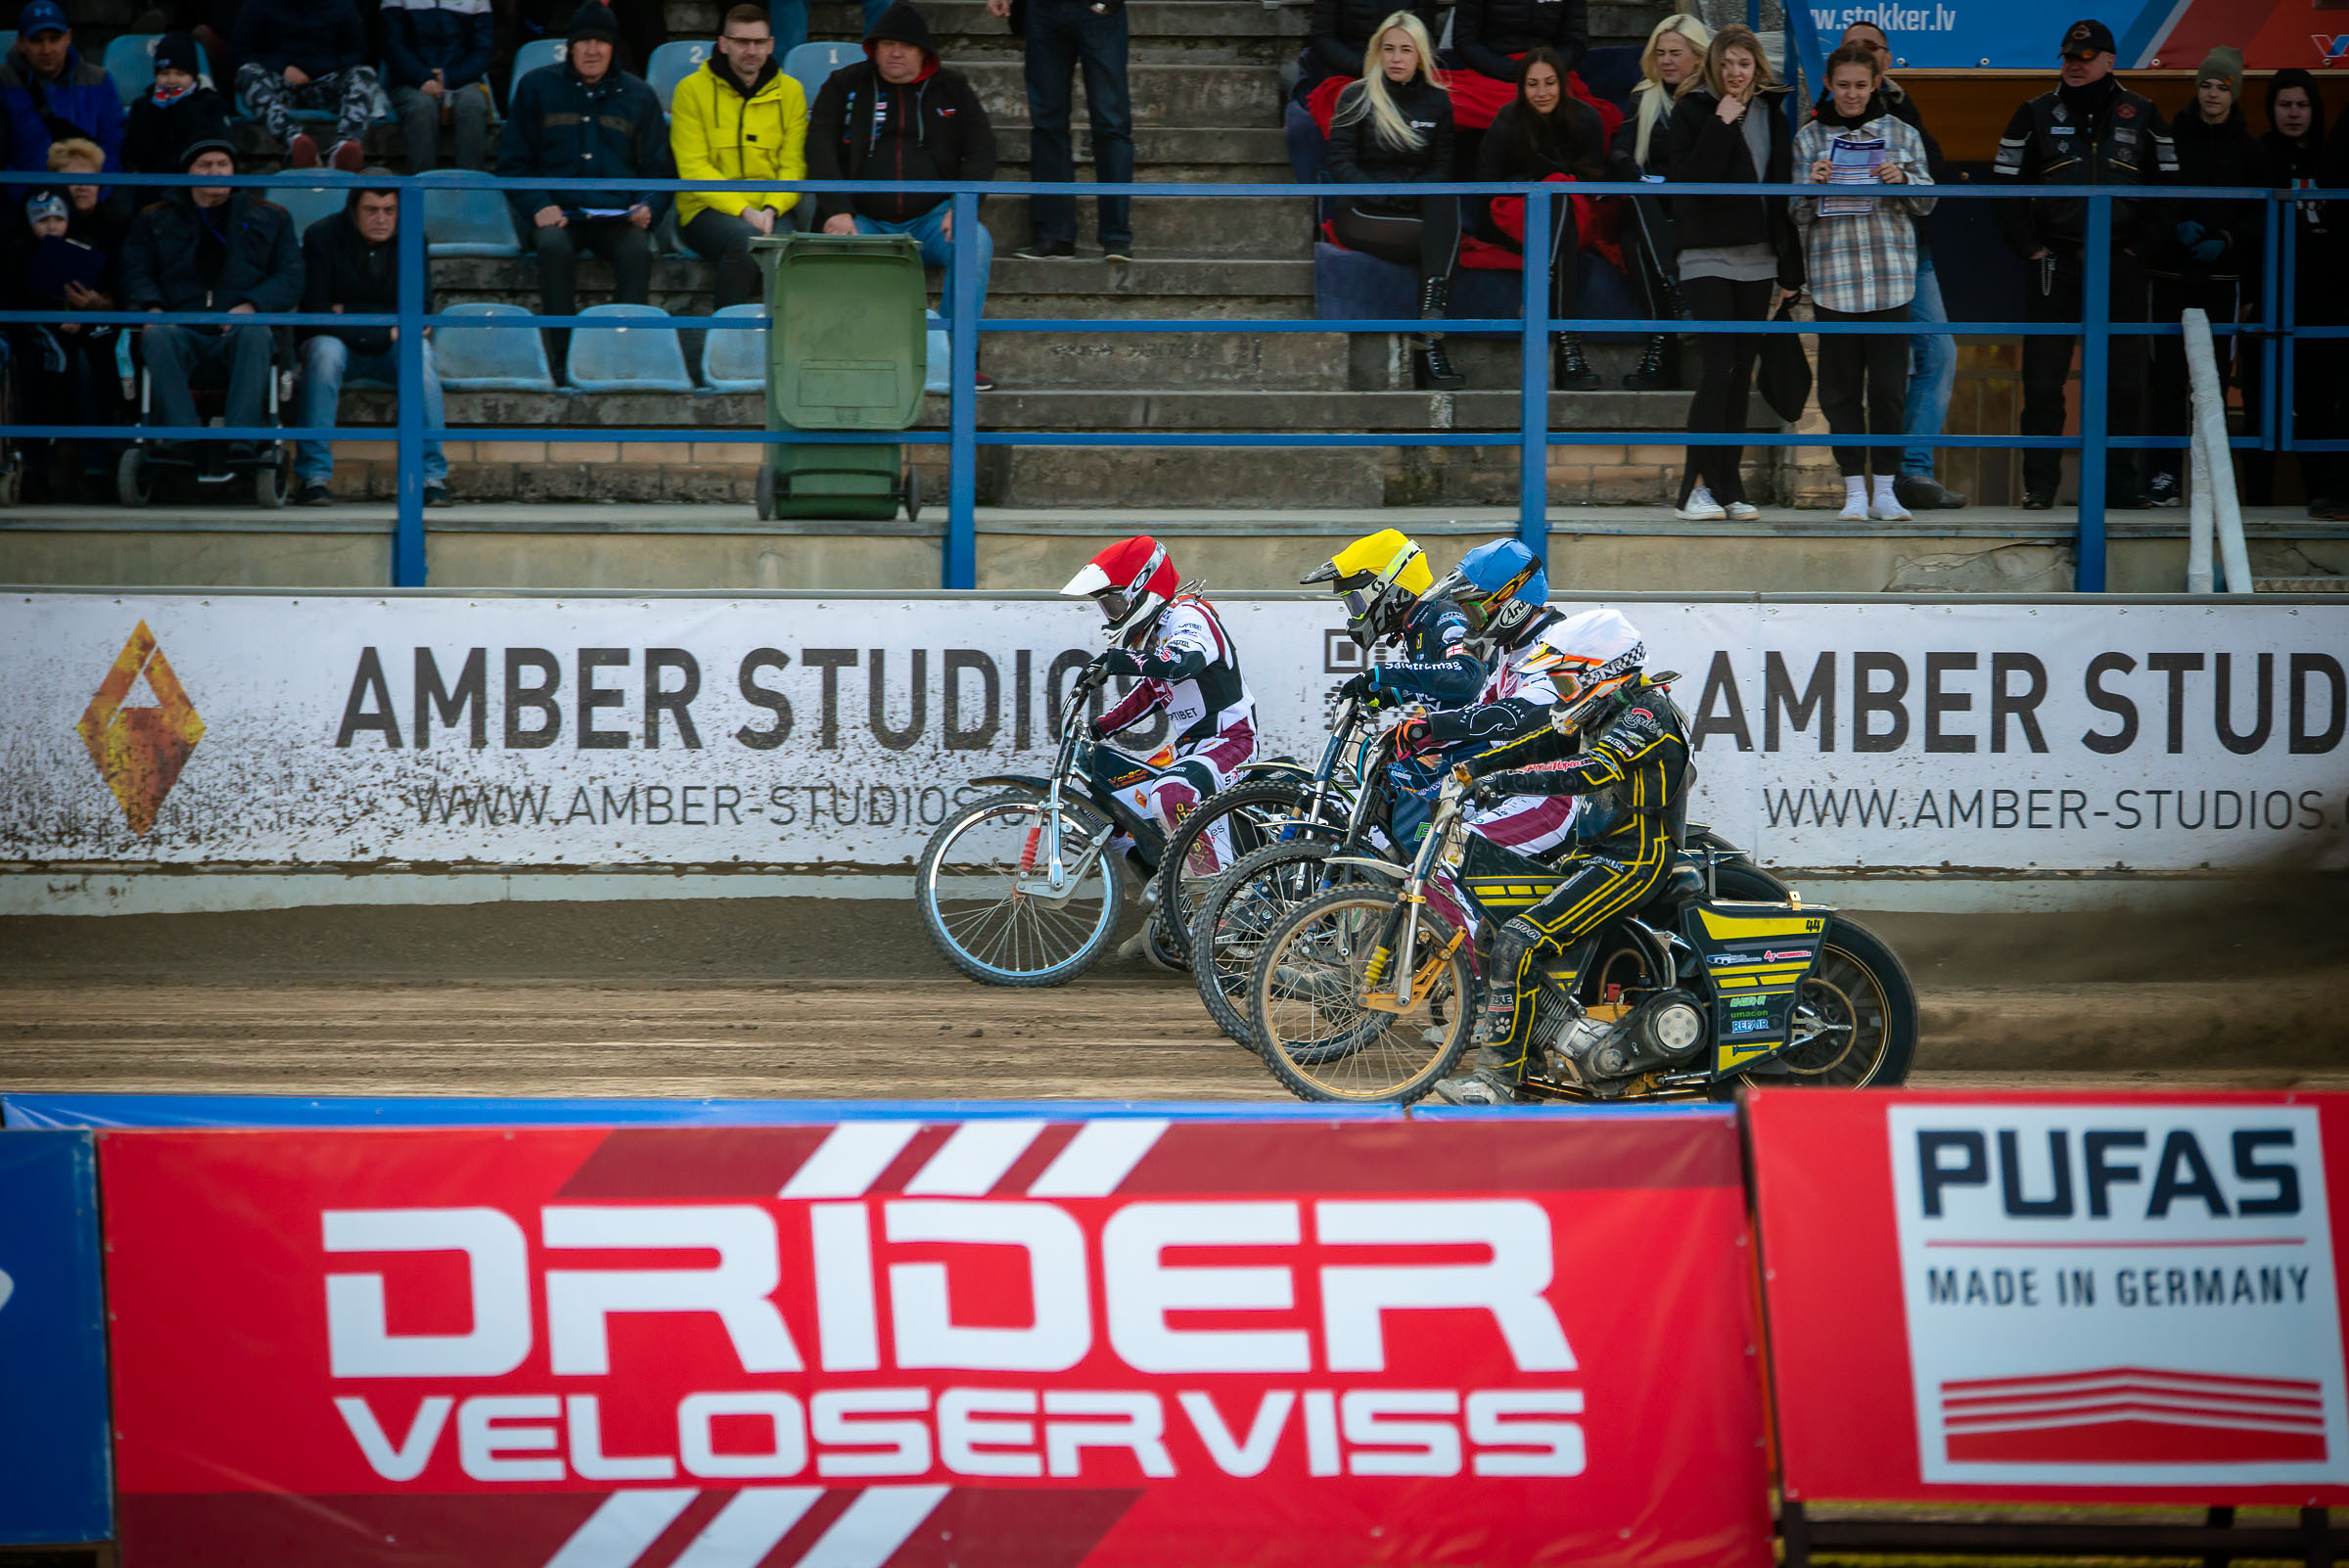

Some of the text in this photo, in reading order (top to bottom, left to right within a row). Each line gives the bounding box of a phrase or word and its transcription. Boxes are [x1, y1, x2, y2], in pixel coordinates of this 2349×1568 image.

[1810, 3, 1957, 30] w.stokker.lv
[335, 647, 702, 750] AMBER
[1693, 651, 2348, 755] AMBER STUD
[1763, 787, 2349, 832] WWW.AMBER-STUDIOS.
[1805, 919, 1821, 932] 44
[1915, 1127, 2303, 1220] PUFAS
[321, 1198, 1578, 1379] DRIDER
[1927, 1266, 2311, 1309] MADE IN GERMANY
[334, 1386, 1587, 1481] VELOSERVISS
